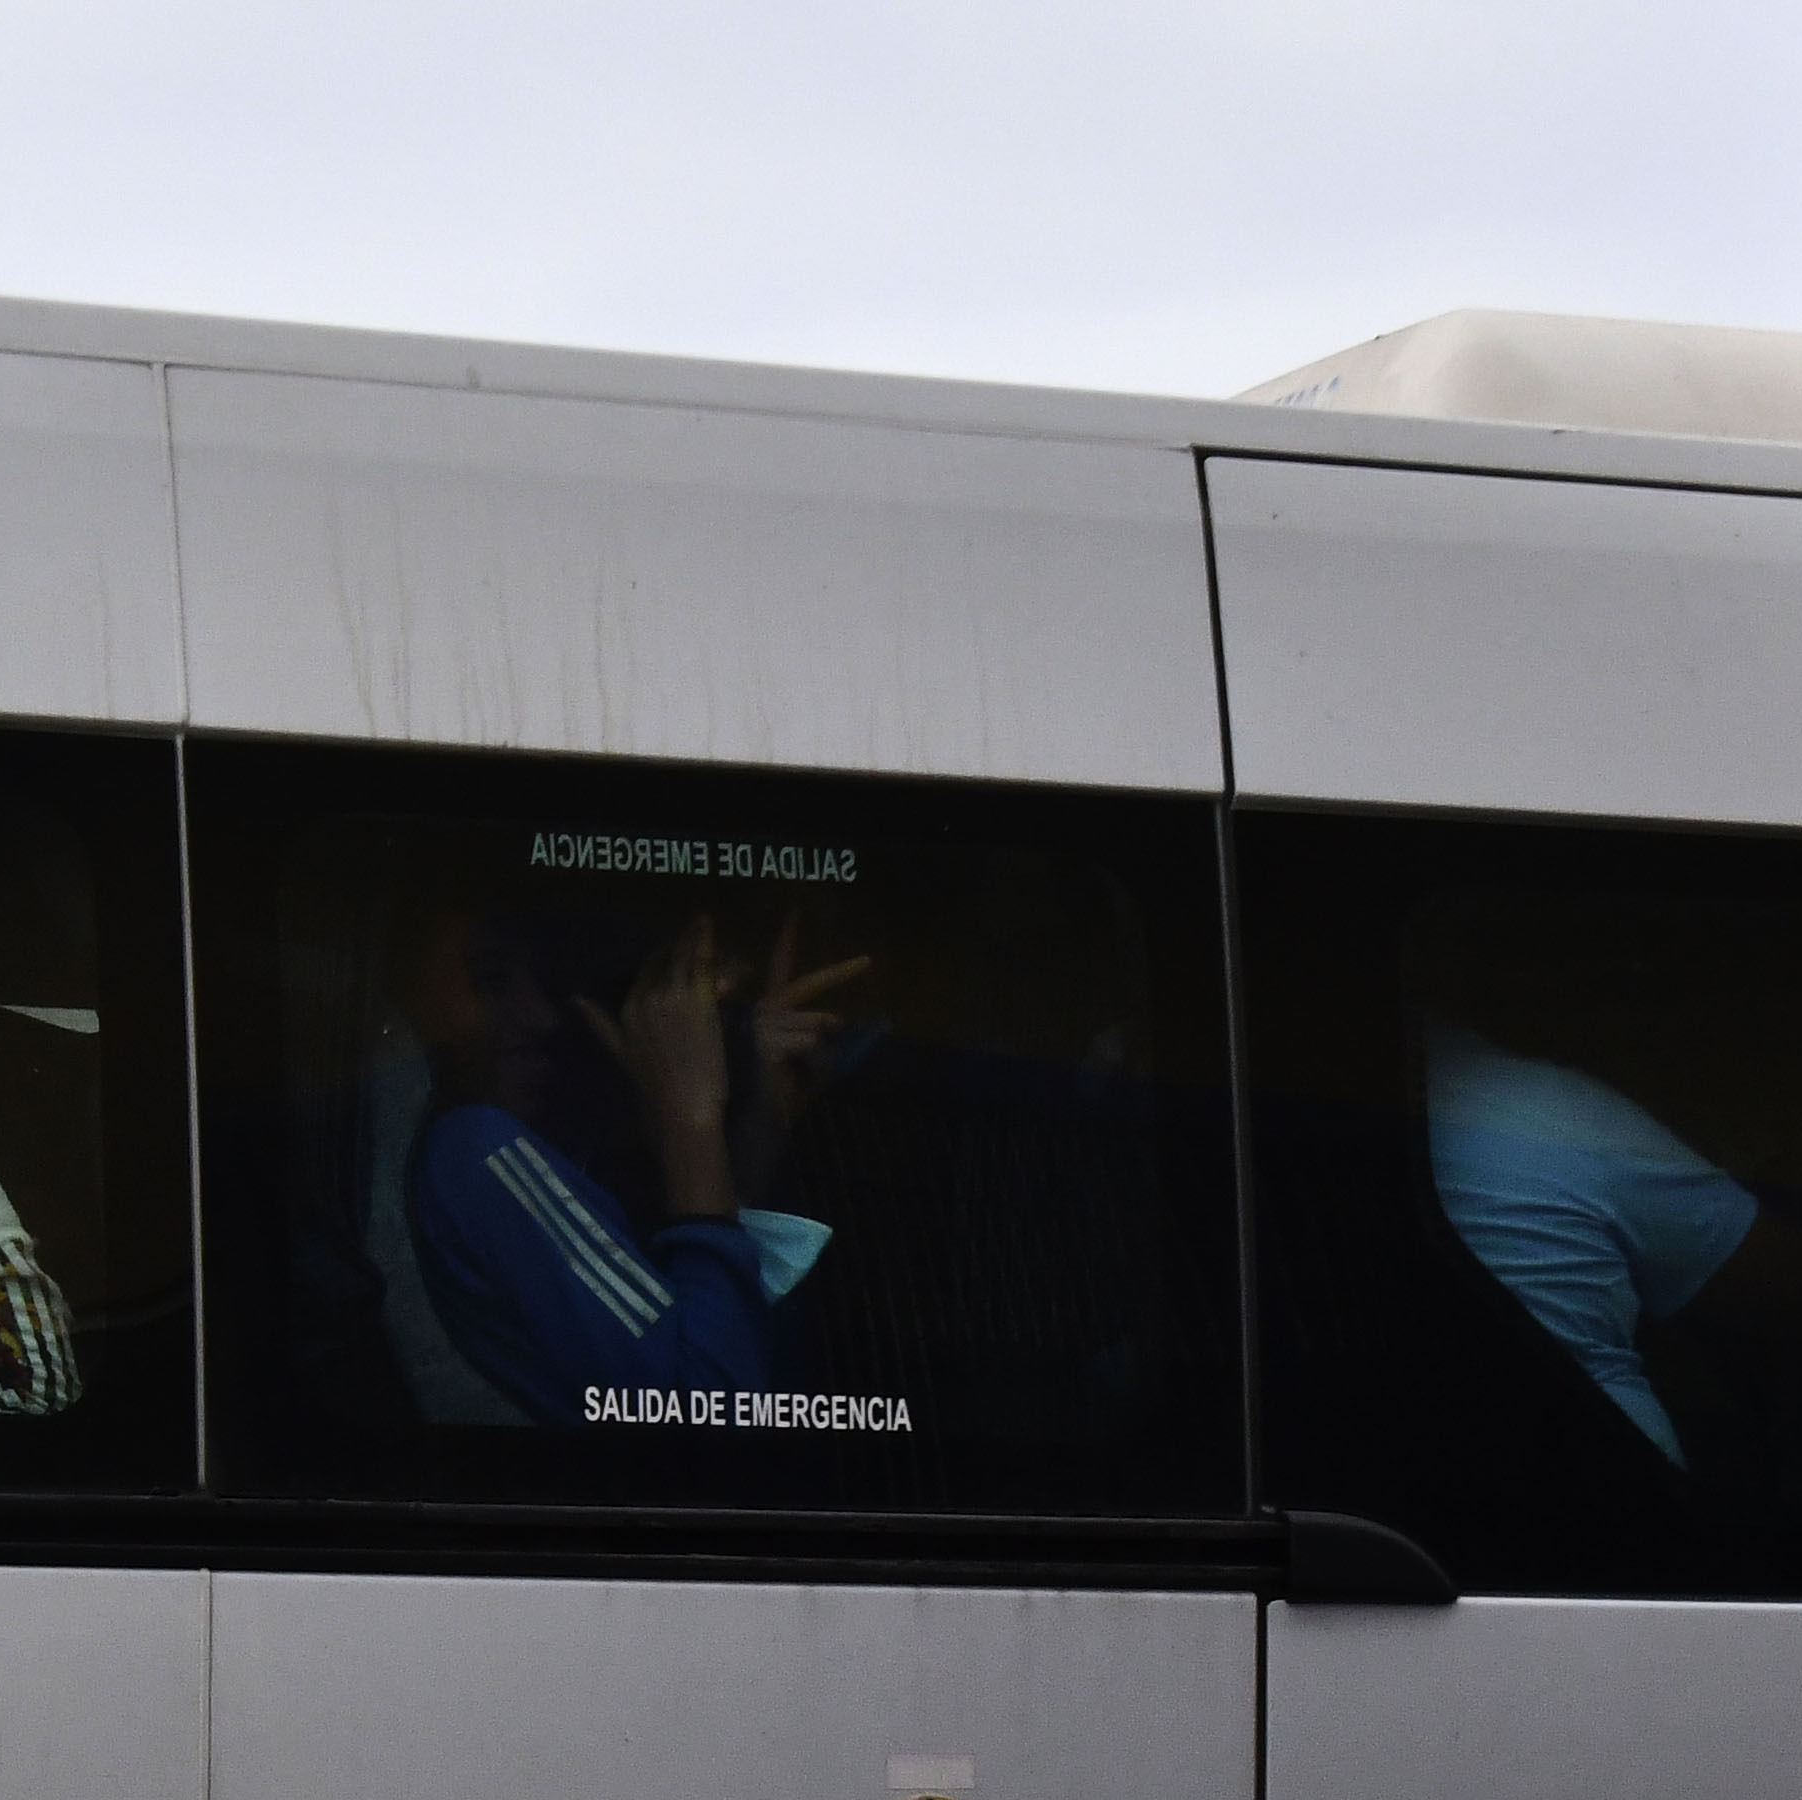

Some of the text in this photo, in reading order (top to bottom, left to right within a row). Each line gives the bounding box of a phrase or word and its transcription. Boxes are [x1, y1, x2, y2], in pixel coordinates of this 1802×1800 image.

[584, 1386, 913, 1432] SALIDA DE EMERGENCIA
